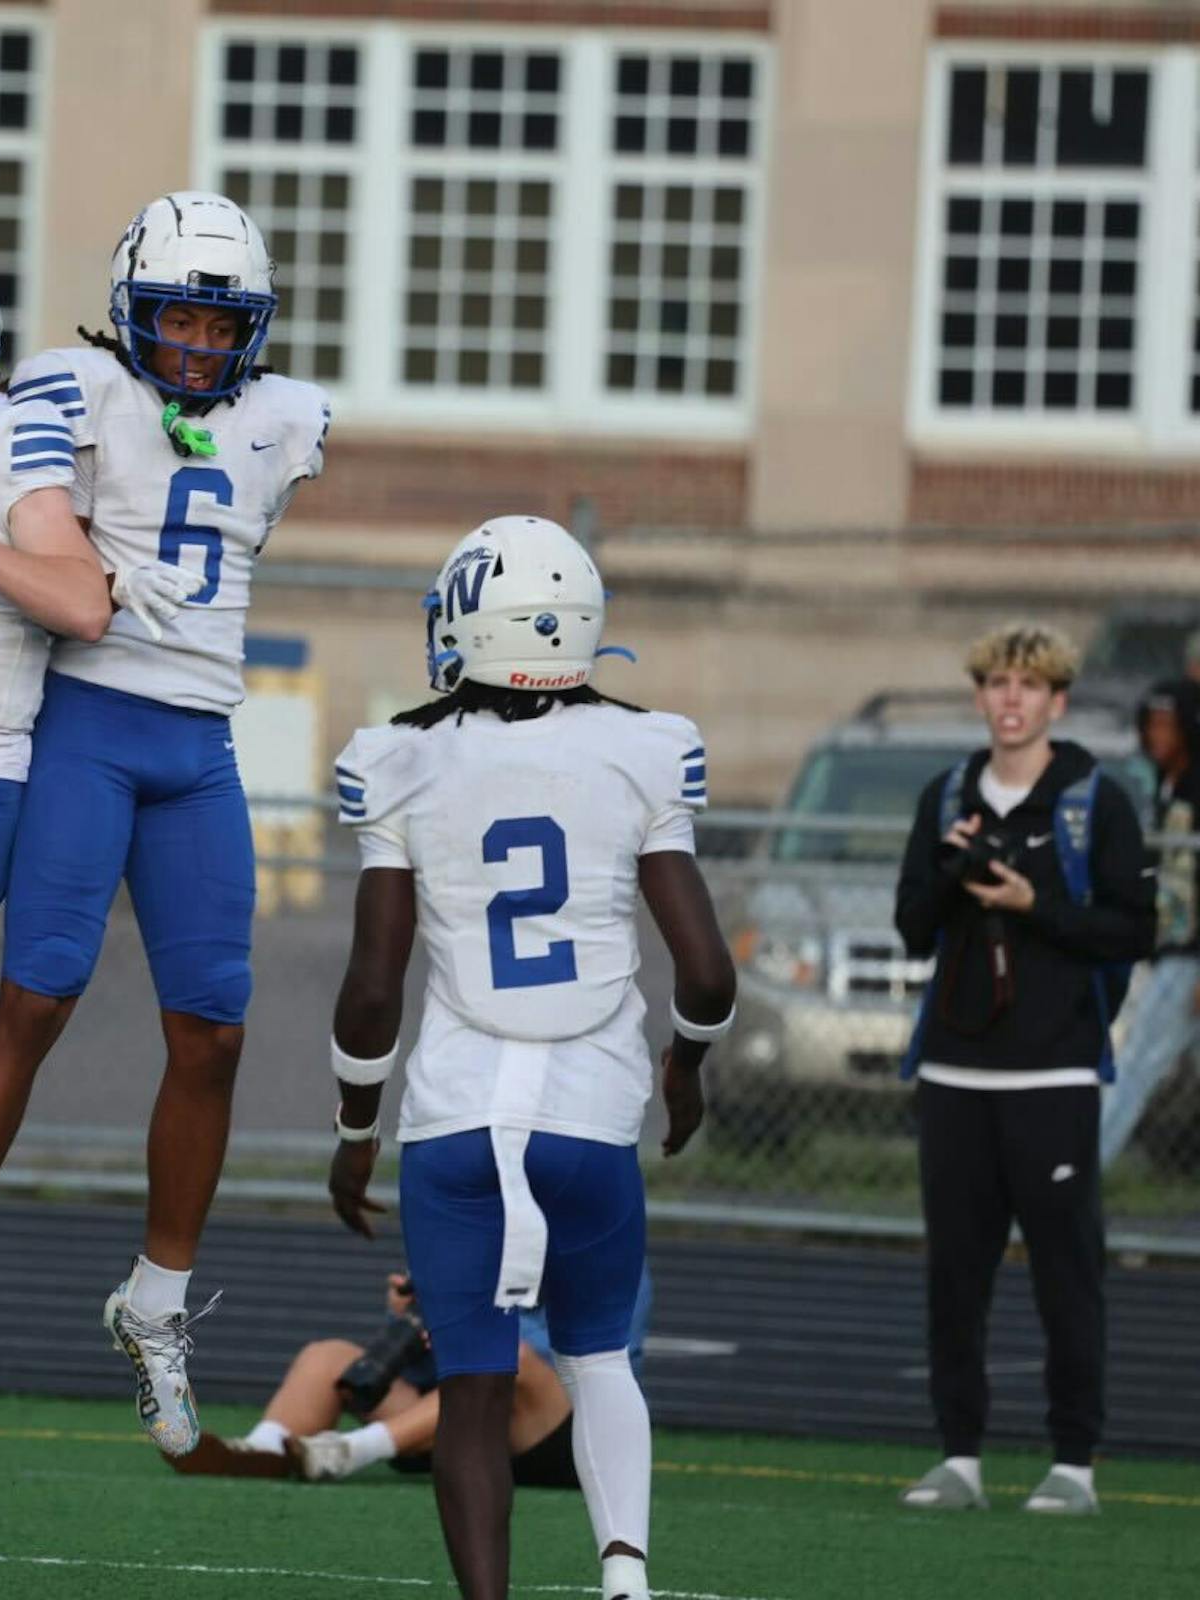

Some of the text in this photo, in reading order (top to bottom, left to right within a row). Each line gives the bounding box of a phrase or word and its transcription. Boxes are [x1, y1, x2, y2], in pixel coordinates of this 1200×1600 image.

[158, 466, 234, 605] 6
[446, 561, 491, 624] N
[482, 816, 579, 990] 2
